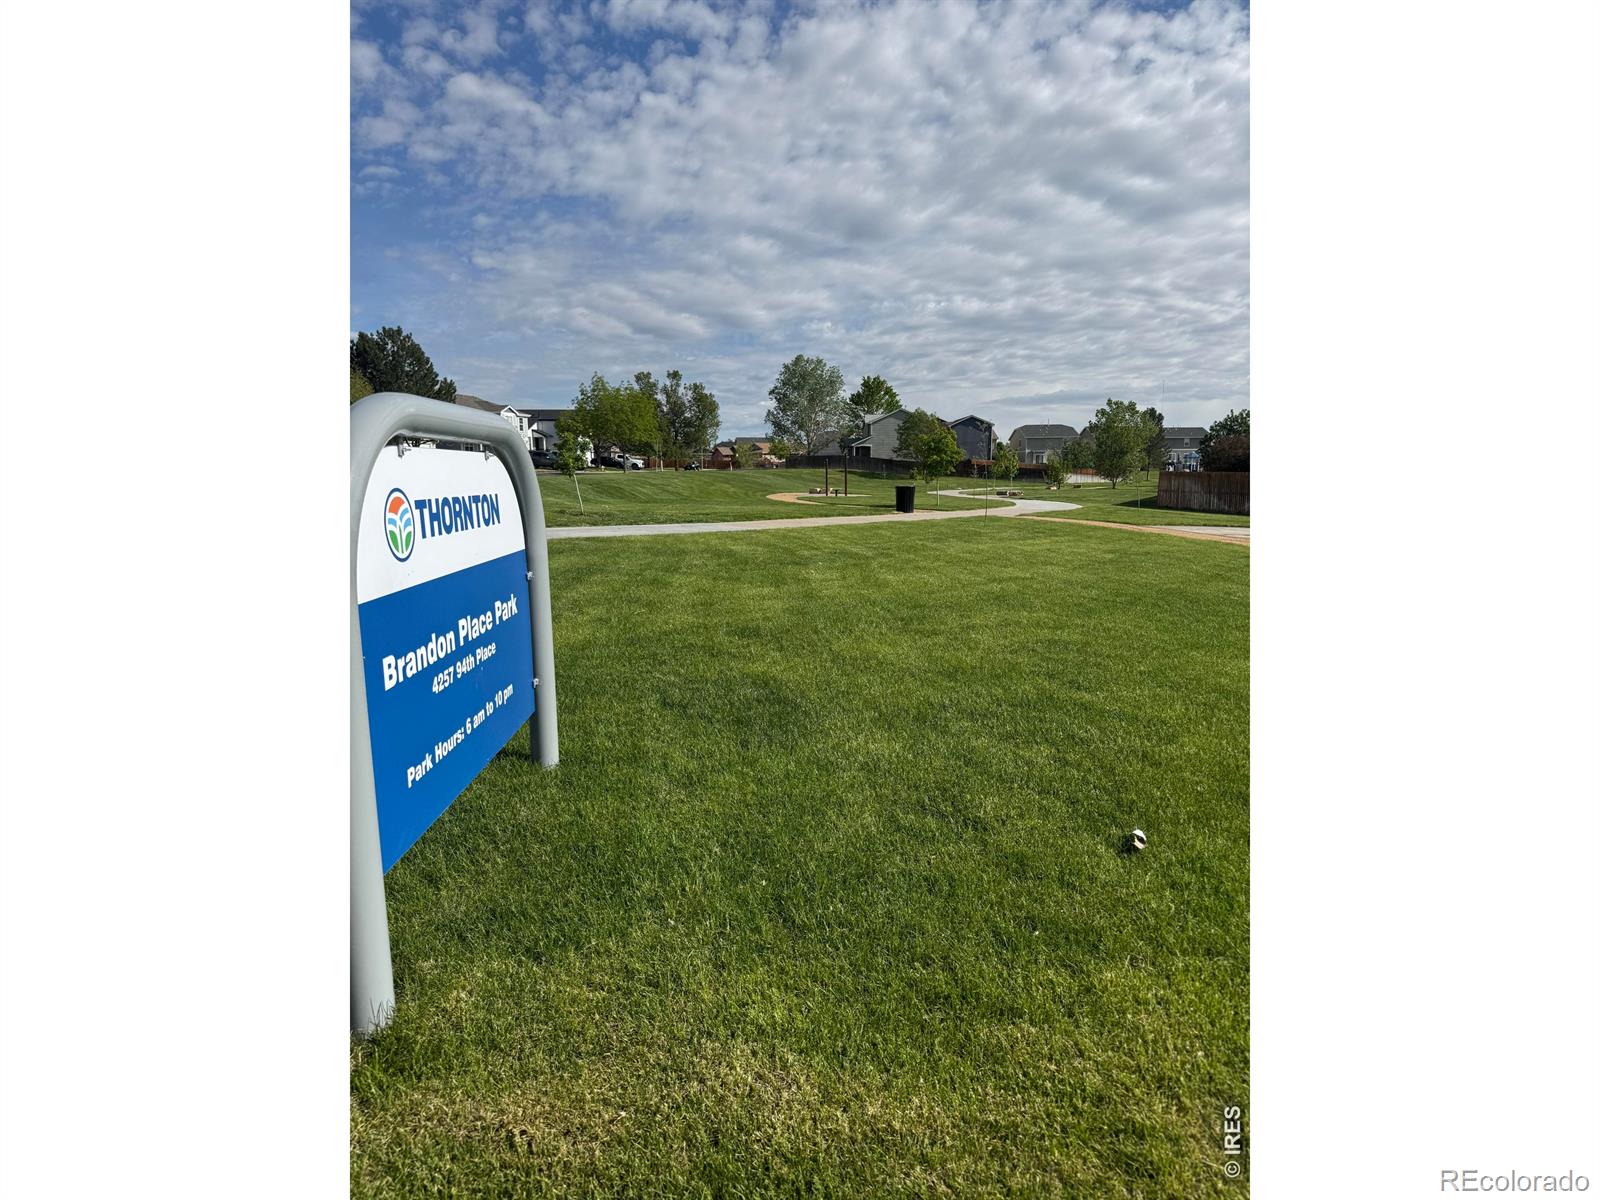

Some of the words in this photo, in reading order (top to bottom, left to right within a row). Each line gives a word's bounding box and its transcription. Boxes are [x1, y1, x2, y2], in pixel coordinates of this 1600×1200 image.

[414, 493, 501, 539] THORNTON
[382, 630, 456, 691] Brandon
[457, 610, 493, 647] Place
[494, 593, 518, 625] Park
[432, 666, 454, 694] 4257
[456, 654, 475, 679] 94th
[475, 641, 496, 665] Place
[407, 752, 433, 789] Park
[434, 727, 465, 764] Hours:
[466, 717, 472, 735] 6
[473, 709, 485, 728] am
[486, 701, 494, 717] to
[495, 690, 503, 708] 10
[503, 683, 514, 704] pm
